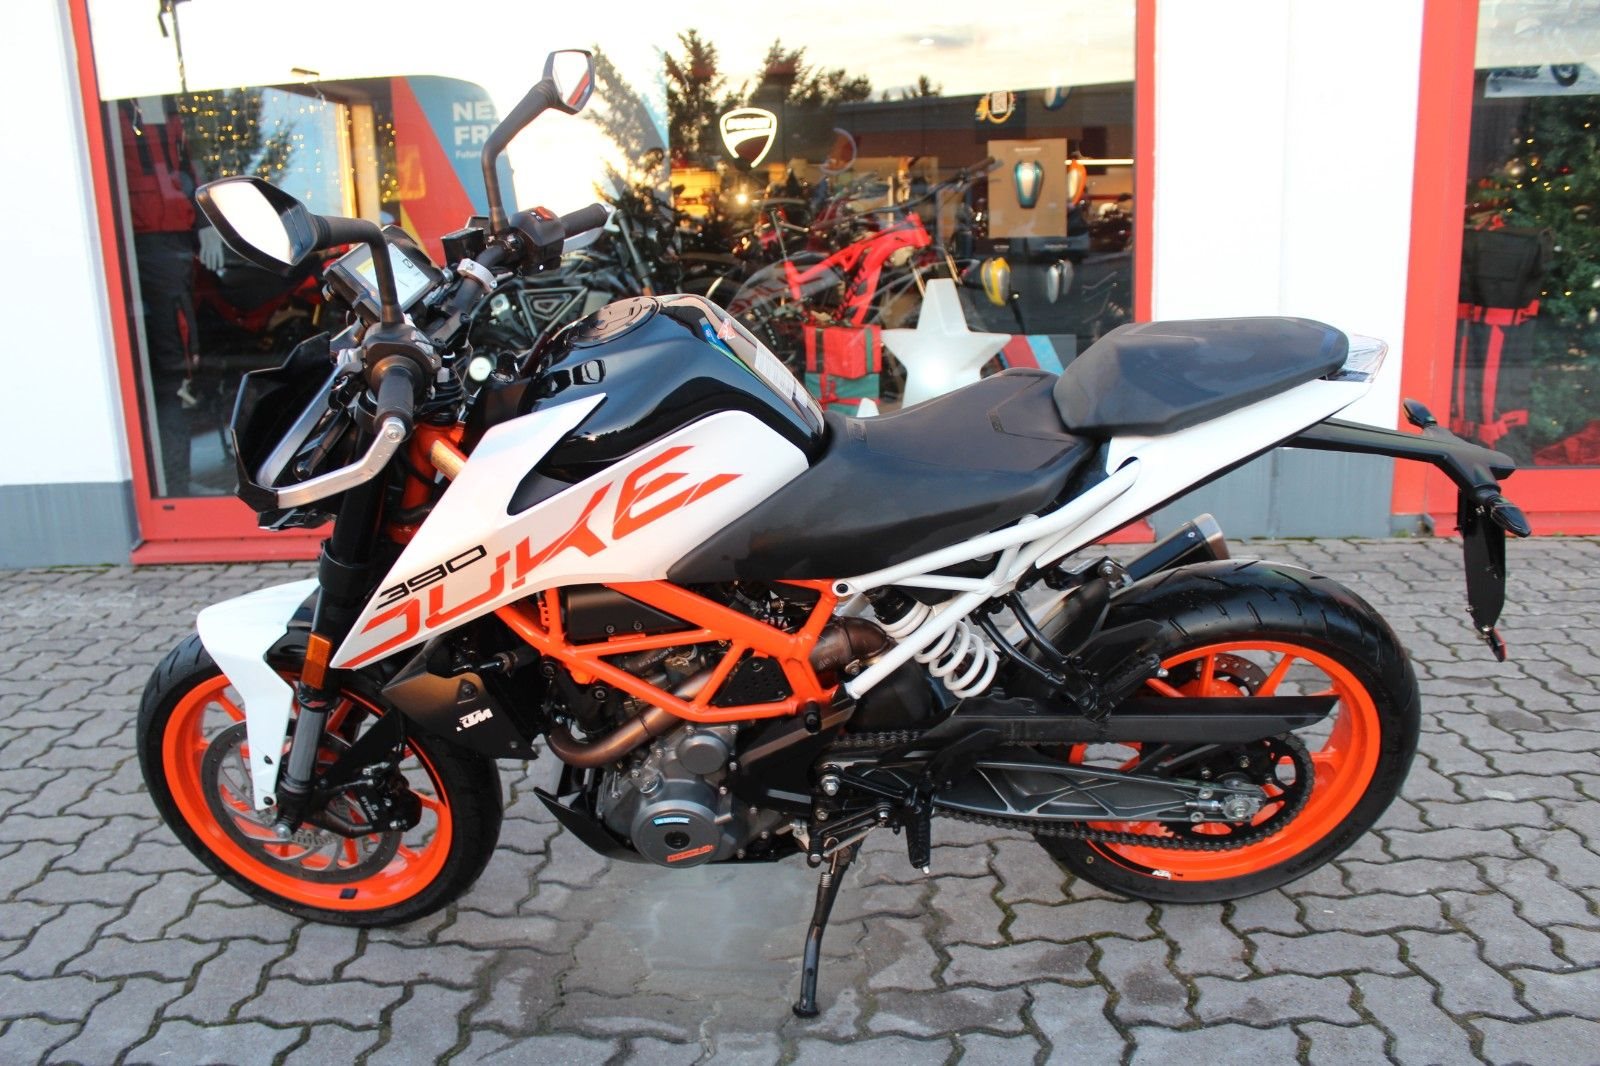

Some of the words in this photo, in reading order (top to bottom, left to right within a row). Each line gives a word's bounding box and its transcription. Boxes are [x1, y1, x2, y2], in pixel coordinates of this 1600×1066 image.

[454, 124, 498, 146] FR
[340, 445, 743, 668] DUKE
[376, 544, 487, 611] 390
[456, 708, 493, 732] KTM
